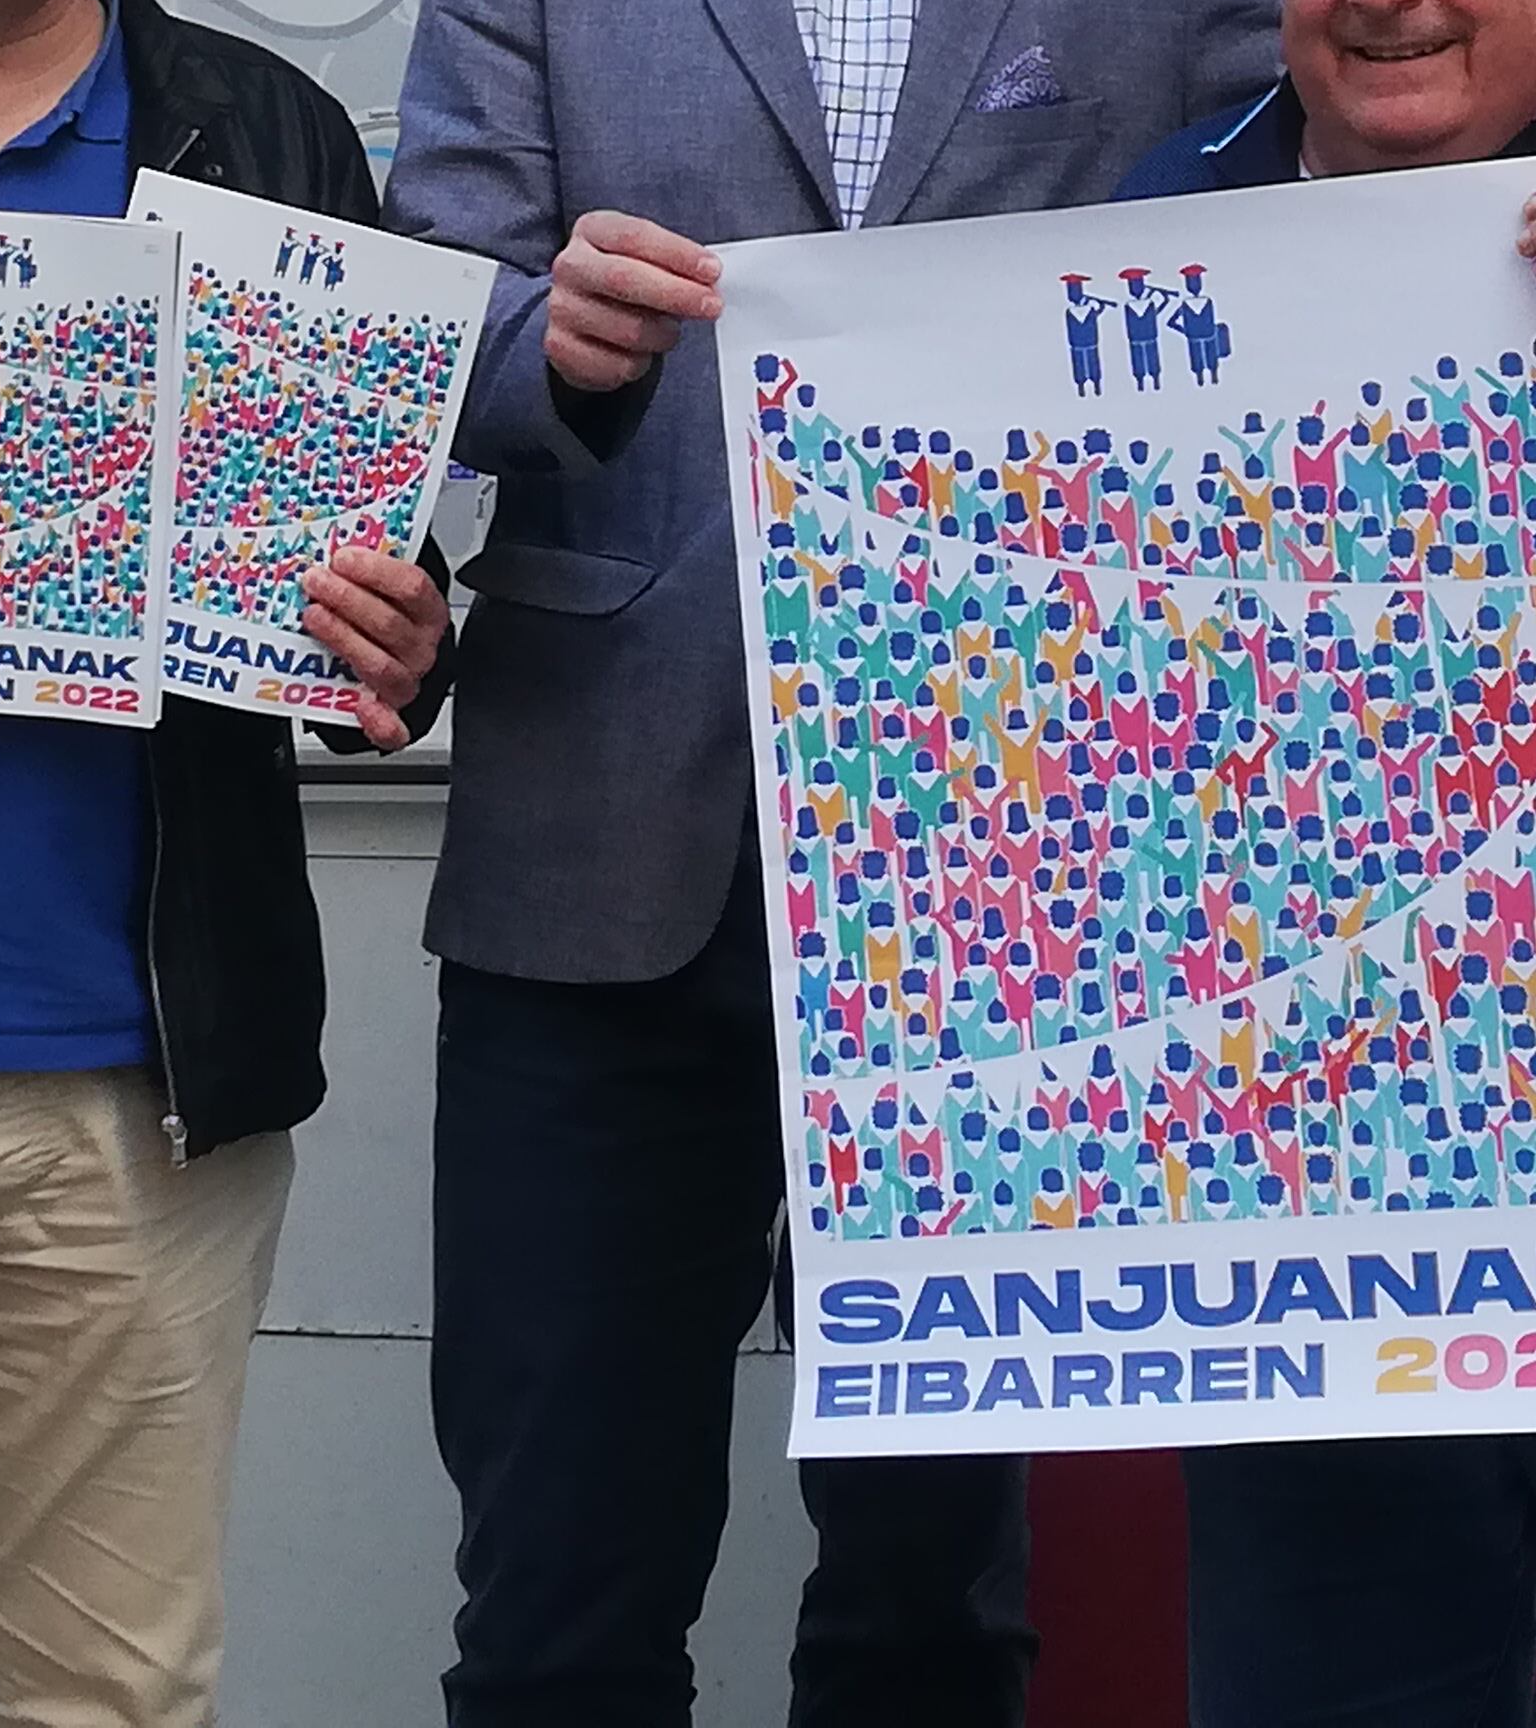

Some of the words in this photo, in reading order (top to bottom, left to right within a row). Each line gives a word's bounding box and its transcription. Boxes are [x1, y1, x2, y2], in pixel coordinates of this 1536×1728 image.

[34, 680, 140, 713] 2022
[254, 678, 361, 714] 2022
[814, 1342, 1326, 1419] EIBARREN
